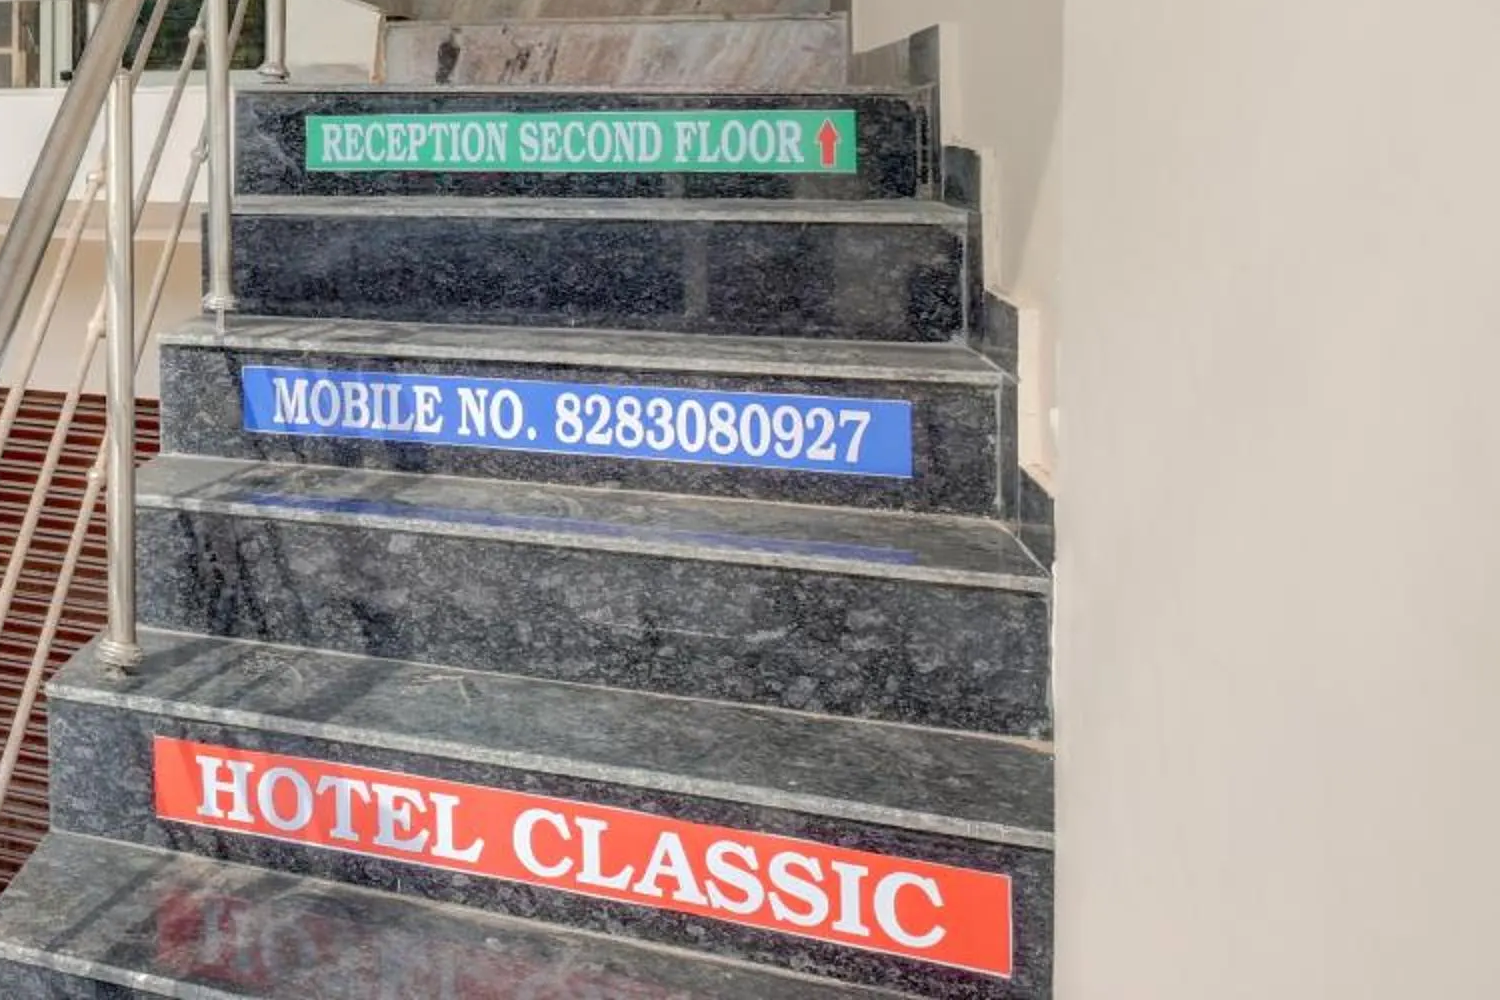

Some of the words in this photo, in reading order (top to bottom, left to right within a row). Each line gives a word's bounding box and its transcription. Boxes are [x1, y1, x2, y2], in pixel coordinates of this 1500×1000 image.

[322, 122, 507, 163] RECEPTION
[519, 120, 662, 163] SECOND
[675, 119, 804, 163] FLOOR
[273, 377, 443, 433] MOBILE
[457, 387, 537, 440] NO.
[555, 393, 871, 463] 8283080927
[195, 755, 484, 863] HOTEL
[512, 808, 946, 948] CLASSIC
